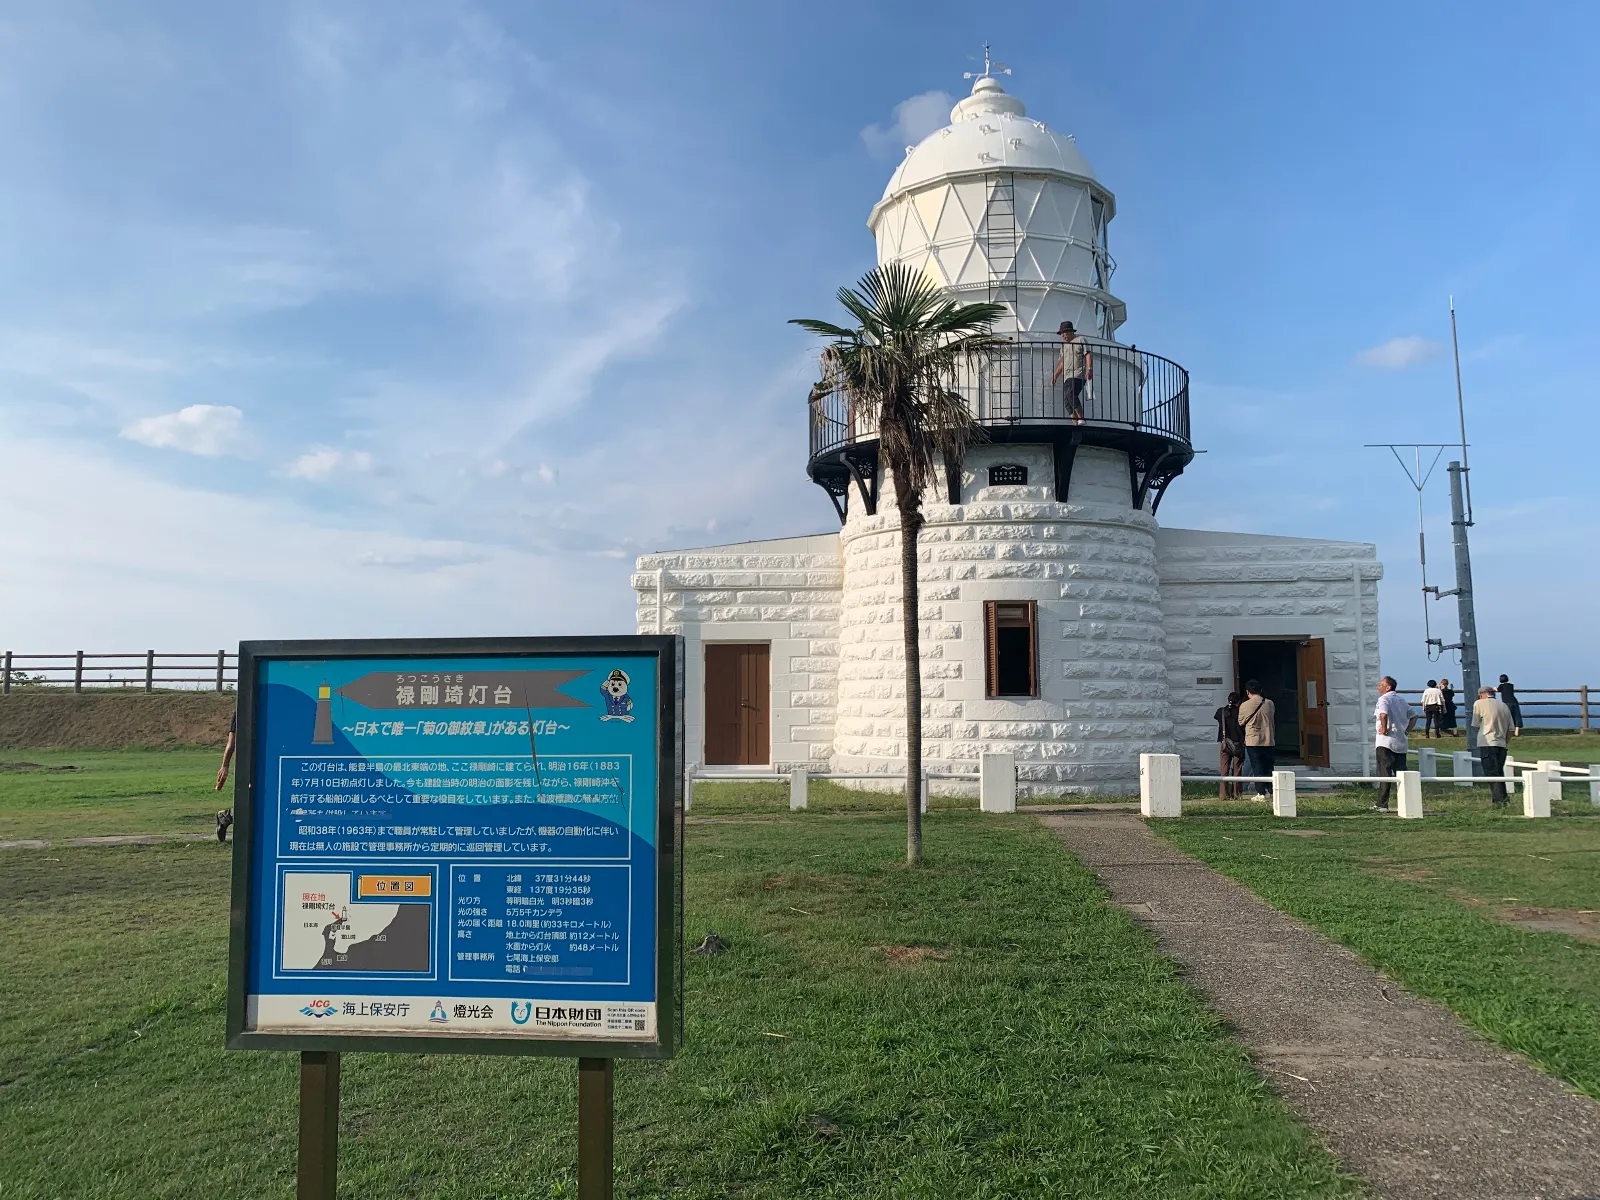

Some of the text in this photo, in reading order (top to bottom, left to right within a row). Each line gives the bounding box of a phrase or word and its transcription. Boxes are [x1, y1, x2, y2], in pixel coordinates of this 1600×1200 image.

[396, 685, 513, 705] 禄剛埼灯台
[310, 1000, 330, 1008] JCG
[343, 1002, 410, 1017] 海上保安庁
[454, 1004, 494, 1019] 燈光会
[536, 1007, 602, 1020] 日本財団
